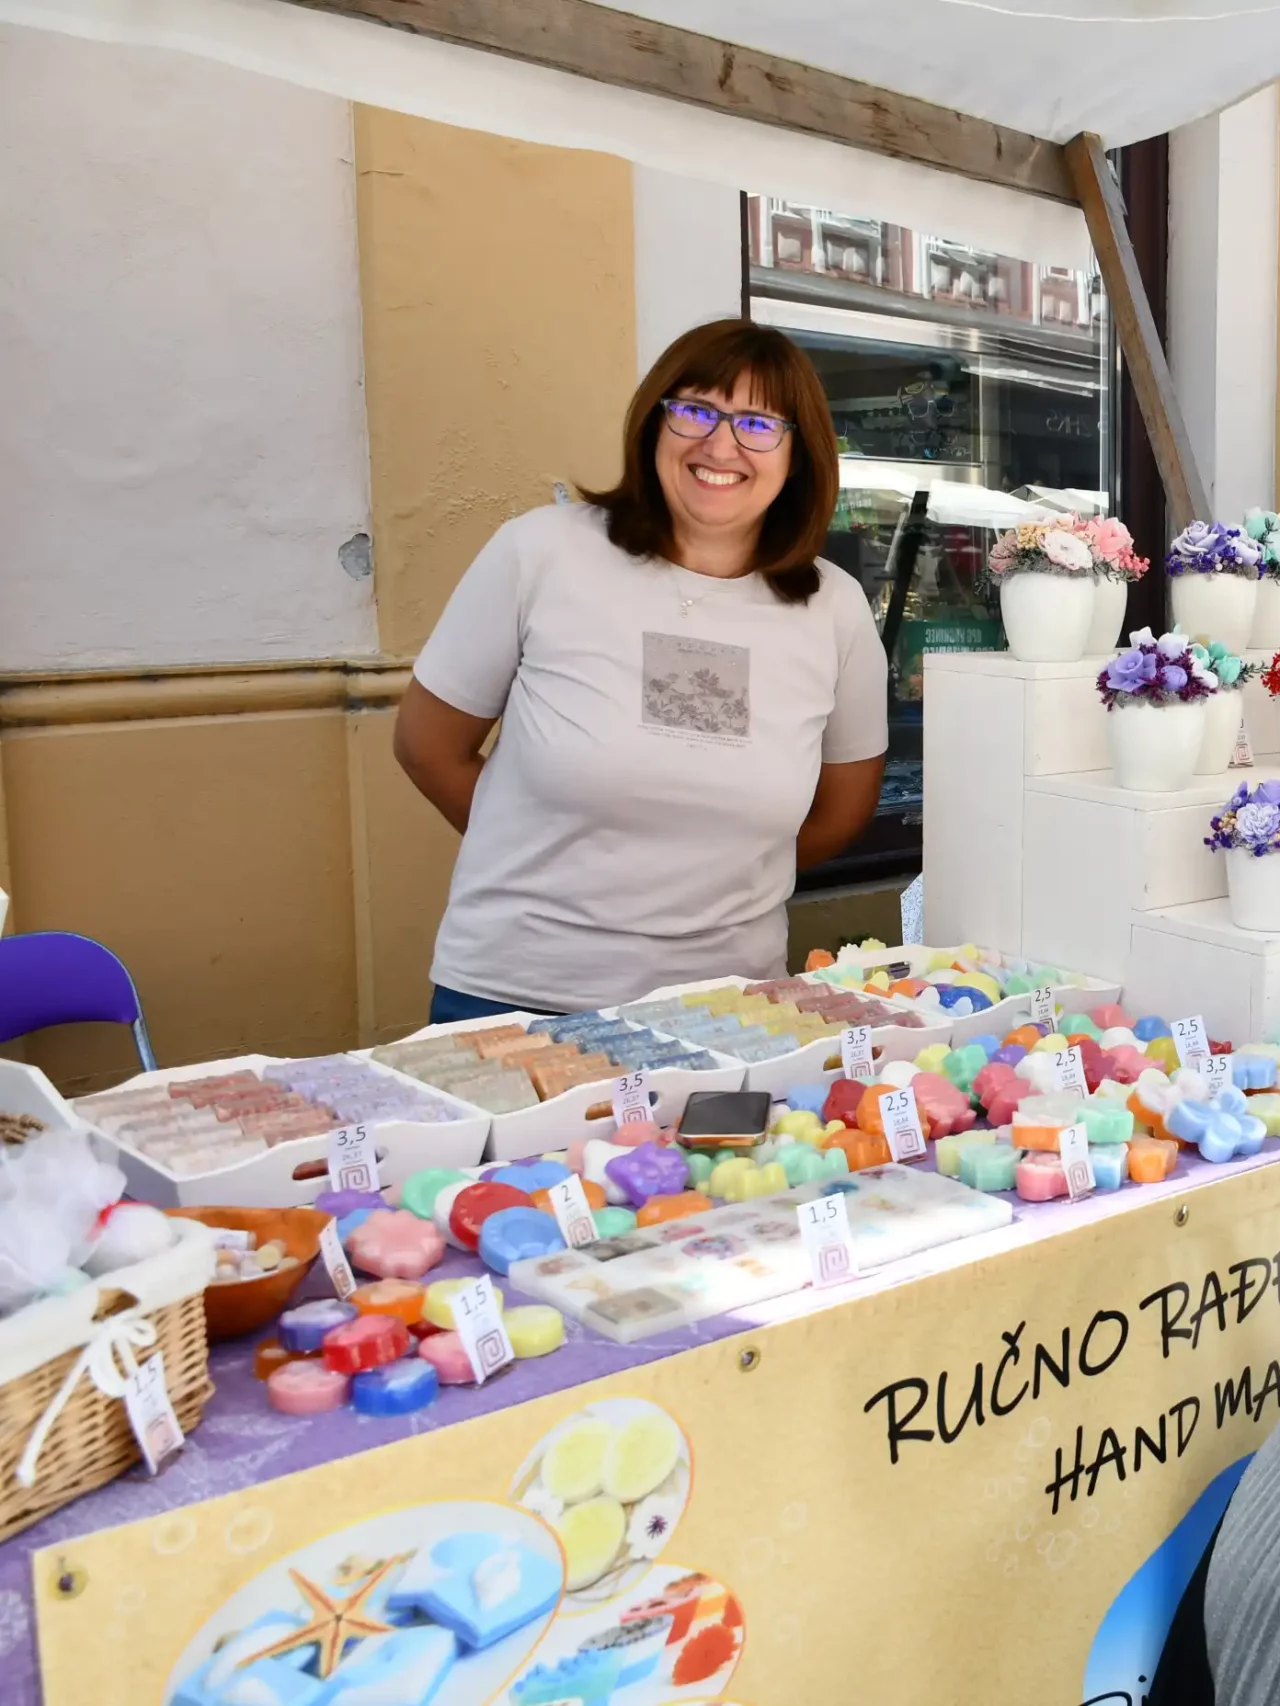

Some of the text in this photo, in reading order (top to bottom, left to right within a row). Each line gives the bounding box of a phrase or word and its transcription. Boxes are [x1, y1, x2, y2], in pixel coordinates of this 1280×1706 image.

[1035, 986, 1051, 1003] 2,5
[847, 1028, 867, 1045] 3,5
[1177, 1019, 1198, 1036] 2,5
[1055, 1048, 1076, 1067] 2,5
[1206, 1056, 1227, 1075] 3,5
[619, 1073, 643, 1092] 3,5
[885, 1091, 909, 1112] 2,5
[337, 1125, 367, 1146] 3,5
[1068, 1128, 1077, 1145] 2
[561, 1184, 572, 1202] 2
[808, 1200, 837, 1224] 1,5
[461, 1283, 487, 1316] 1,5
[864, 1309, 1129, 1464] RUČNO
[1045, 1396, 1201, 1515] HAND
